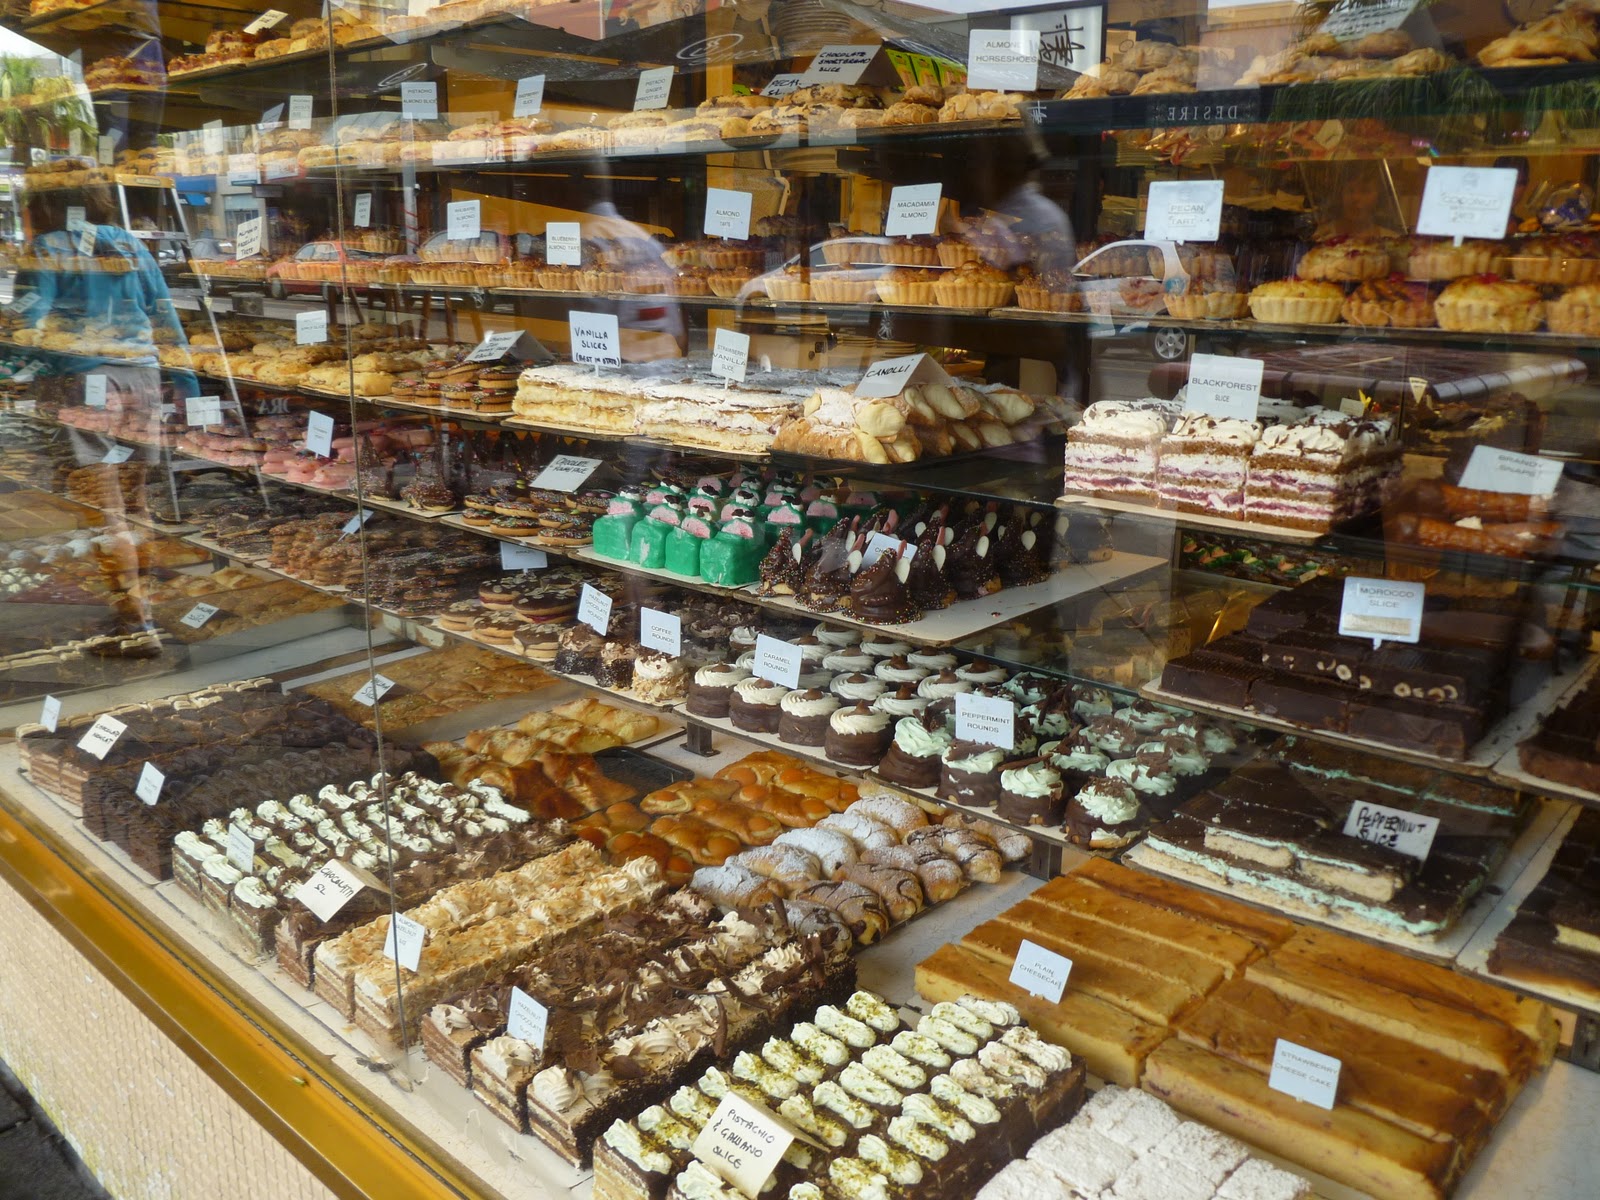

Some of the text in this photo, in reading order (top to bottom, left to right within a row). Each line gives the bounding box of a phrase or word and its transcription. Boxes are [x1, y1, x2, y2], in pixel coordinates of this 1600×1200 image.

[986, 41, 1022, 49] ALMOND
[819, 51, 866, 59] CHOCOLATE
[975, 55, 1037, 64] HORSESHOES
[897, 200, 936, 209] MACADAMIA
[1170, 203, 1205, 214] PECAN
[715, 209, 741, 218] ALMOND
[900, 211, 928, 219] ALMOND
[551, 235, 578, 243] BLUEBERRY
[574, 327, 609, 340] VANILLA
[581, 340, 608, 351] SLICES
[713, 352, 747, 366] VANILLA
[866, 364, 911, 379] CANOLLI
[1191, 377, 1259, 392] BLACKFOREST
[1214, 394, 1231, 403] SLICE
[555, 456, 588, 467] CHOCOLATE
[1359, 586, 1415, 598] MOROCCO
[588, 593, 609, 608] HAZELNUT
[1369, 598, 1400, 609] SLICE
[585, 599, 609, 617] CHOCOLATE
[587, 609, 604, 622] ROUNDS
[651, 624, 672, 636] COFFEE
[651, 632, 675, 645] ROUNDS
[763, 652, 792, 665] CARAMEL
[763, 661, 789, 674] ROUNDS
[961, 711, 1011, 725] PEPPERMINT
[967, 722, 999, 734] ROUNDS
[1358, 807, 1428, 834] PEPPERMINT
[1357, 830, 1399, 849] SLICE
[398, 917, 417, 929] ALMOND
[395, 925, 417, 938] AZELNUT
[1034, 961, 1055, 978] PLAIN
[517, 1000, 543, 1022] HAZELNUT
[1280, 1049, 1338, 1075] STRAWBERRY
[1274, 1061, 1332, 1089] CHEESE CAKE
[726, 1108, 776, 1145] PISTACHIO
[712, 1145, 743, 1170] SLICE
